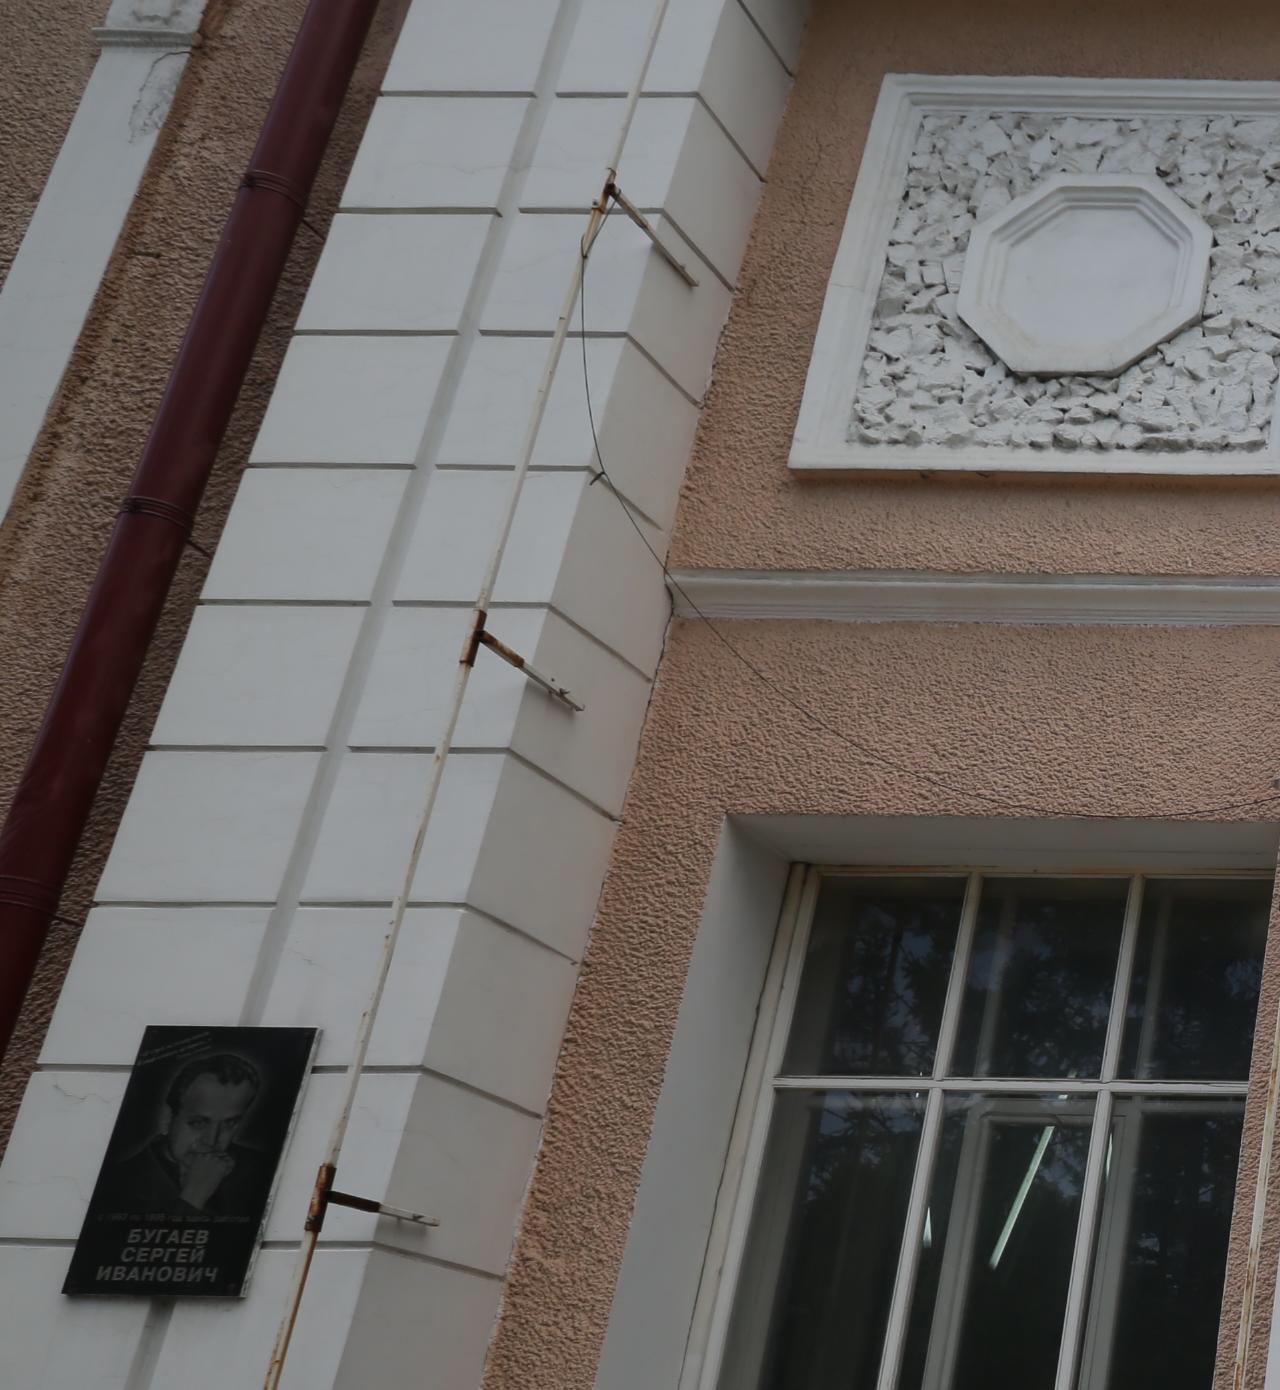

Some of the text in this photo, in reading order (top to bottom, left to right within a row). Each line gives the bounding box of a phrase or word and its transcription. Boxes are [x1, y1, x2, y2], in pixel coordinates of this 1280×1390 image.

[127, 1228, 210, 1245] БУГАЕВ
[120, 1245, 206, 1263] СЕРГЕЙ
[95, 1265, 219, 1283] ИВАНОВИЧ
